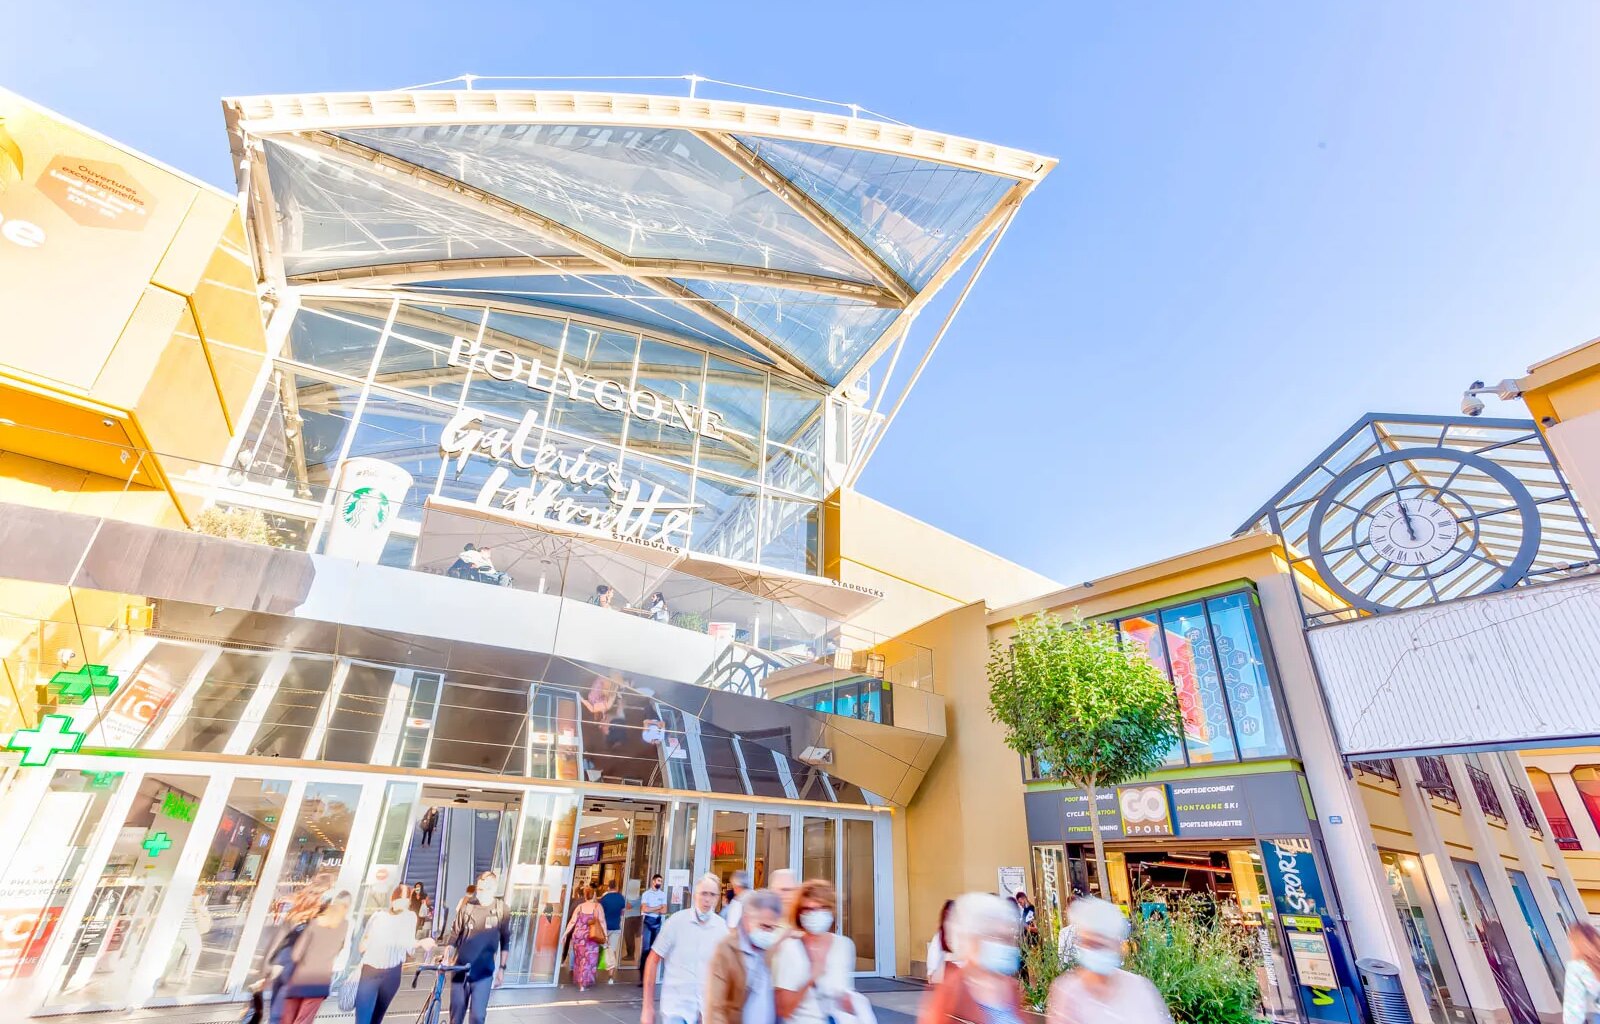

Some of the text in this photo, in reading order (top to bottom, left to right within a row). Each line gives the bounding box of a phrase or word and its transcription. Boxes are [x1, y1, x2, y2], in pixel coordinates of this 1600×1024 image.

[62, 166, 145, 206] exceptionnelles
[79, 165, 137, 195] Ouvertures
[447, 335, 725, 442] POLYGONE
[440, 408, 629, 493] Galeries
[612, 533, 681, 554] STARBUCKS
[1066, 810, 1085, 818] CYCLE
[1120, 787, 1167, 822] GO
[1176, 803, 1223, 812] MONTAGNE
[1126, 825, 1169, 834] SPORT
[1271, 842, 1310, 914] SPORT
